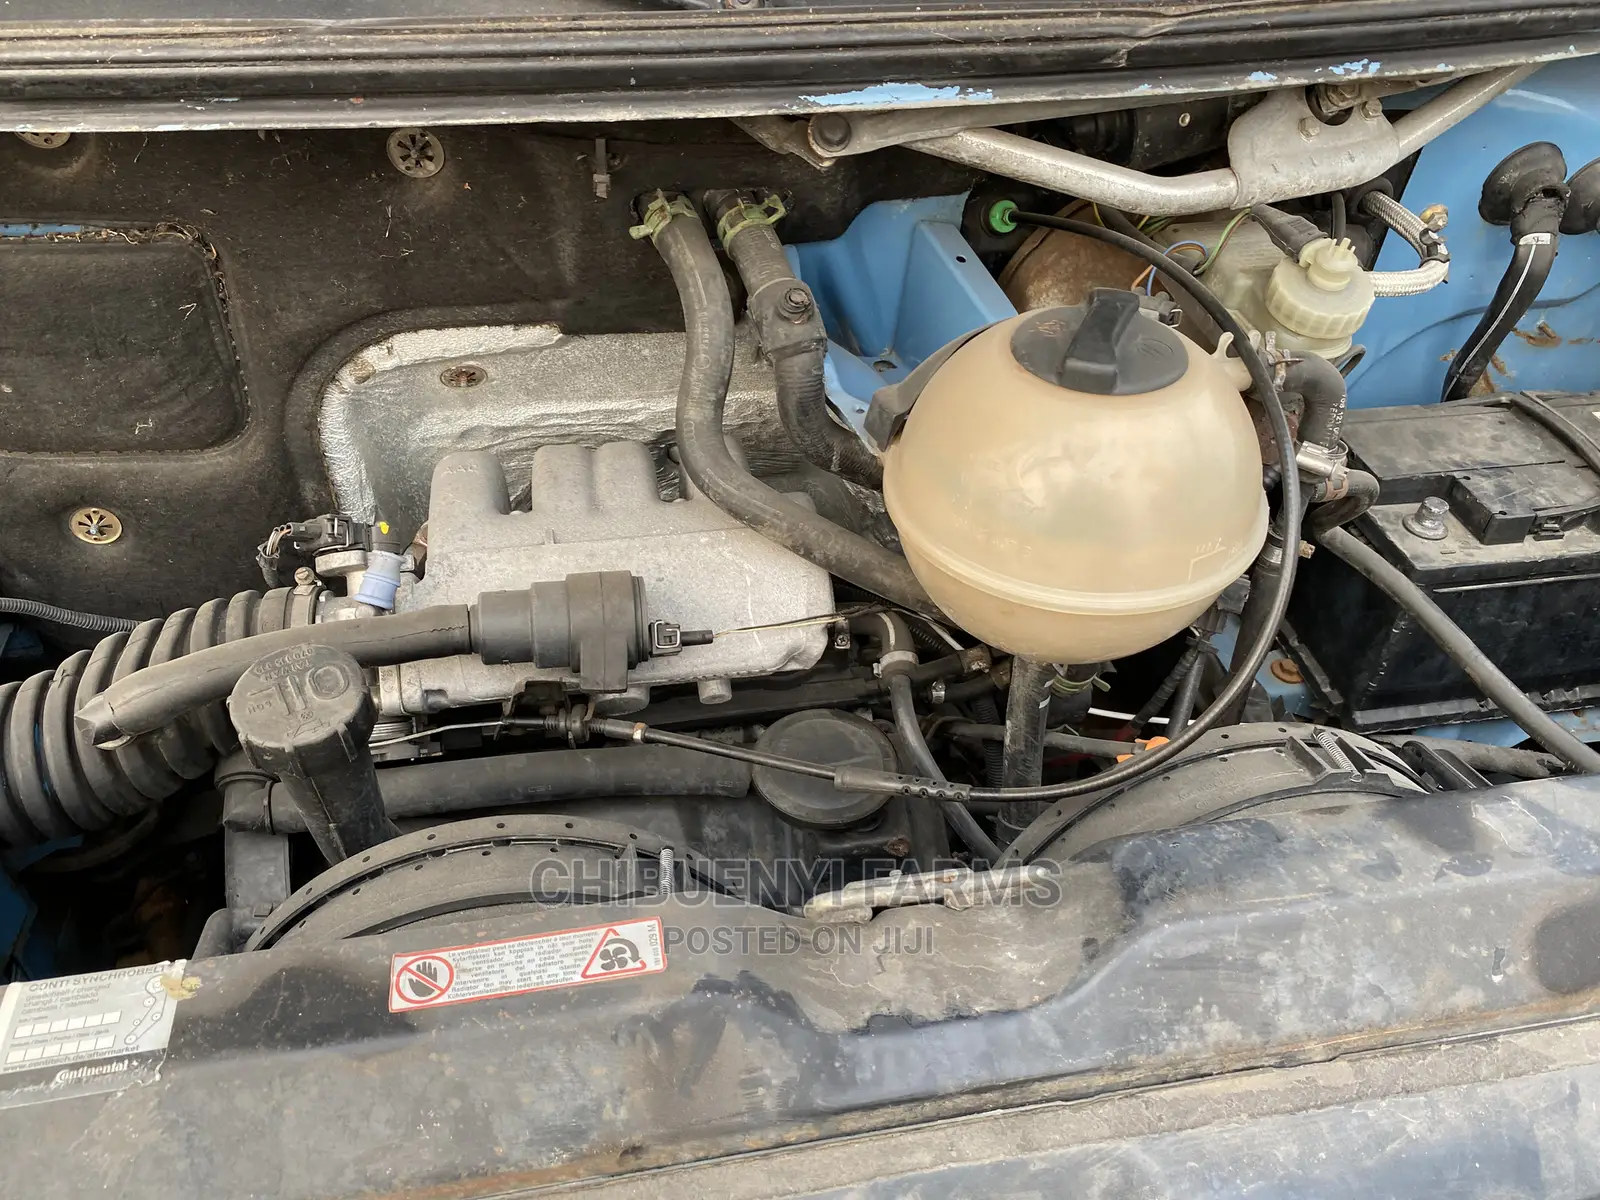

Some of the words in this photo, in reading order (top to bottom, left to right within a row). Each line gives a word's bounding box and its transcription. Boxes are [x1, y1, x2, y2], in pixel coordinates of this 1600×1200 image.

[265, 660, 312, 682] TAIWAN
[247, 662, 350, 717] OIL
[646, 923, 657, 933] M
[29, 980, 69, 992] CONTI
[72, 965, 165, 986] SYNCHROBELT
[55, 1058, 130, 1083] Continental
